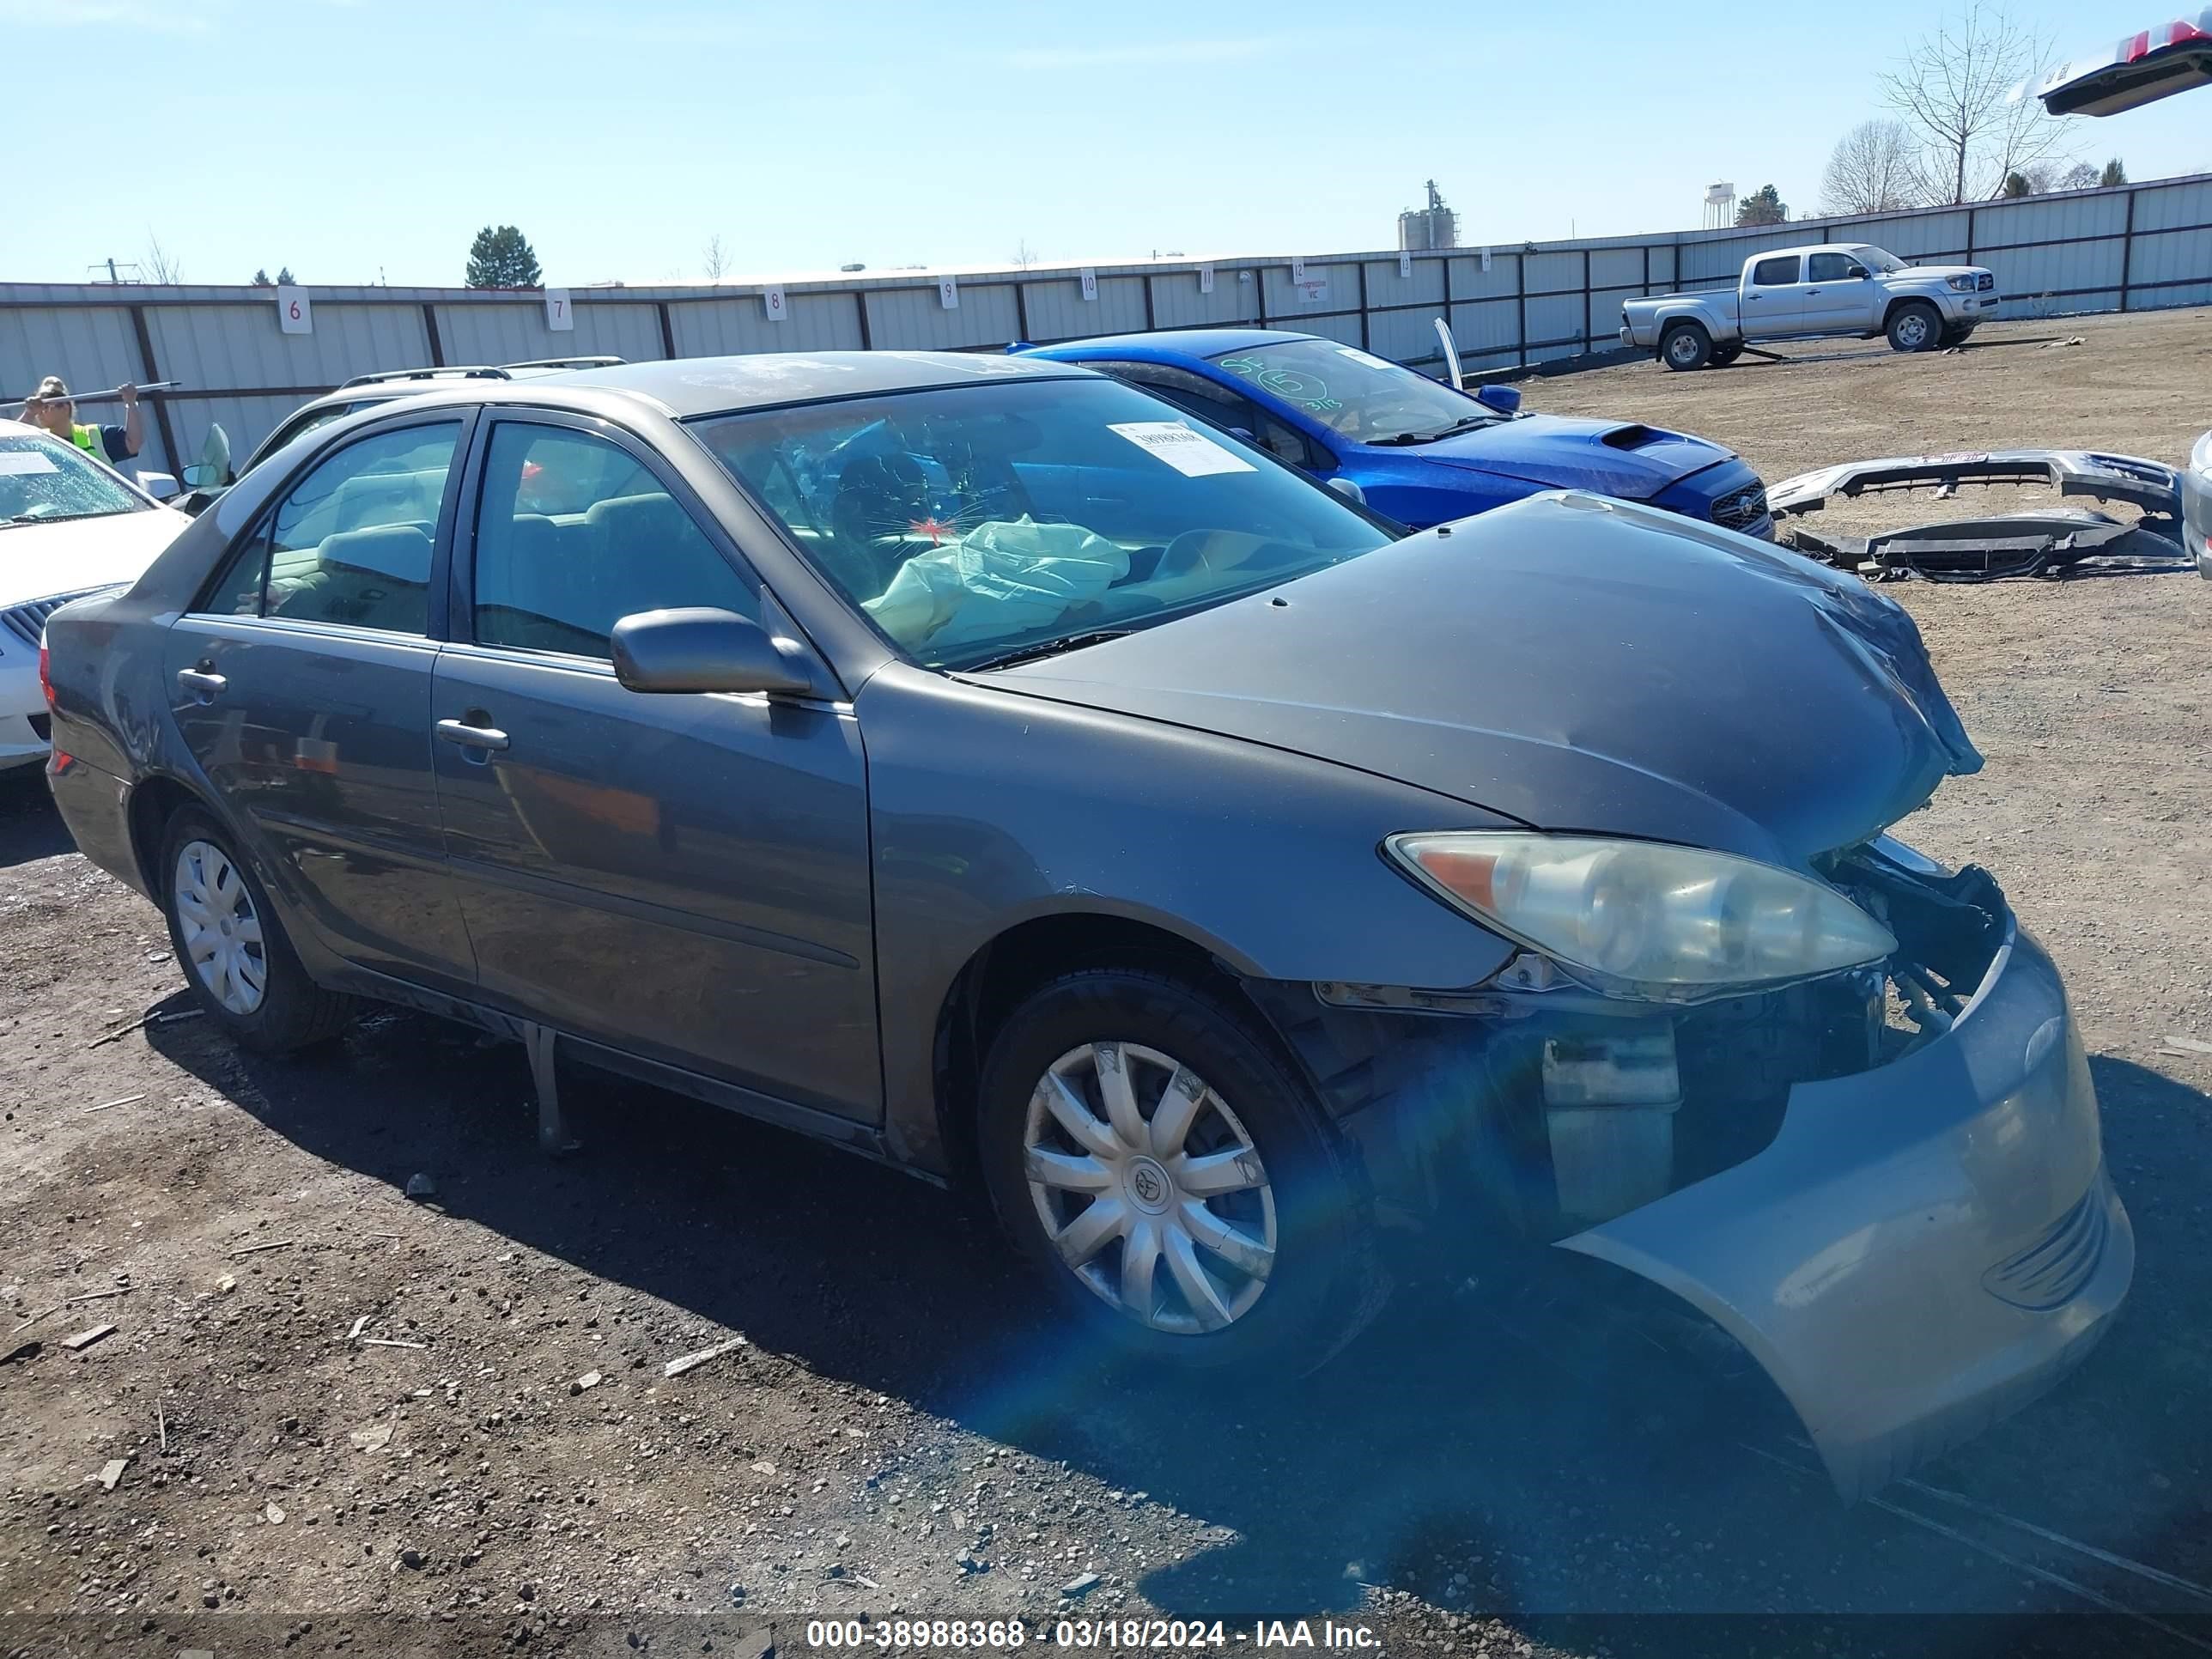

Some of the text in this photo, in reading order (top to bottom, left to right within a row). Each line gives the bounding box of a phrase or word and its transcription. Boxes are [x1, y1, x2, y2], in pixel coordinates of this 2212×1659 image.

[1295, 264, 1303, 276] 12
[1402, 258, 1409, 270] 13
[1085, 276, 1094, 292] 10
[1204, 270, 1211, 284] 11
[945, 283, 953, 298] 9
[772, 293, 781, 310] 8
[289, 301, 301, 320] 6
[554, 301, 563, 319] 7
[1263, 373, 1304, 393] 15
